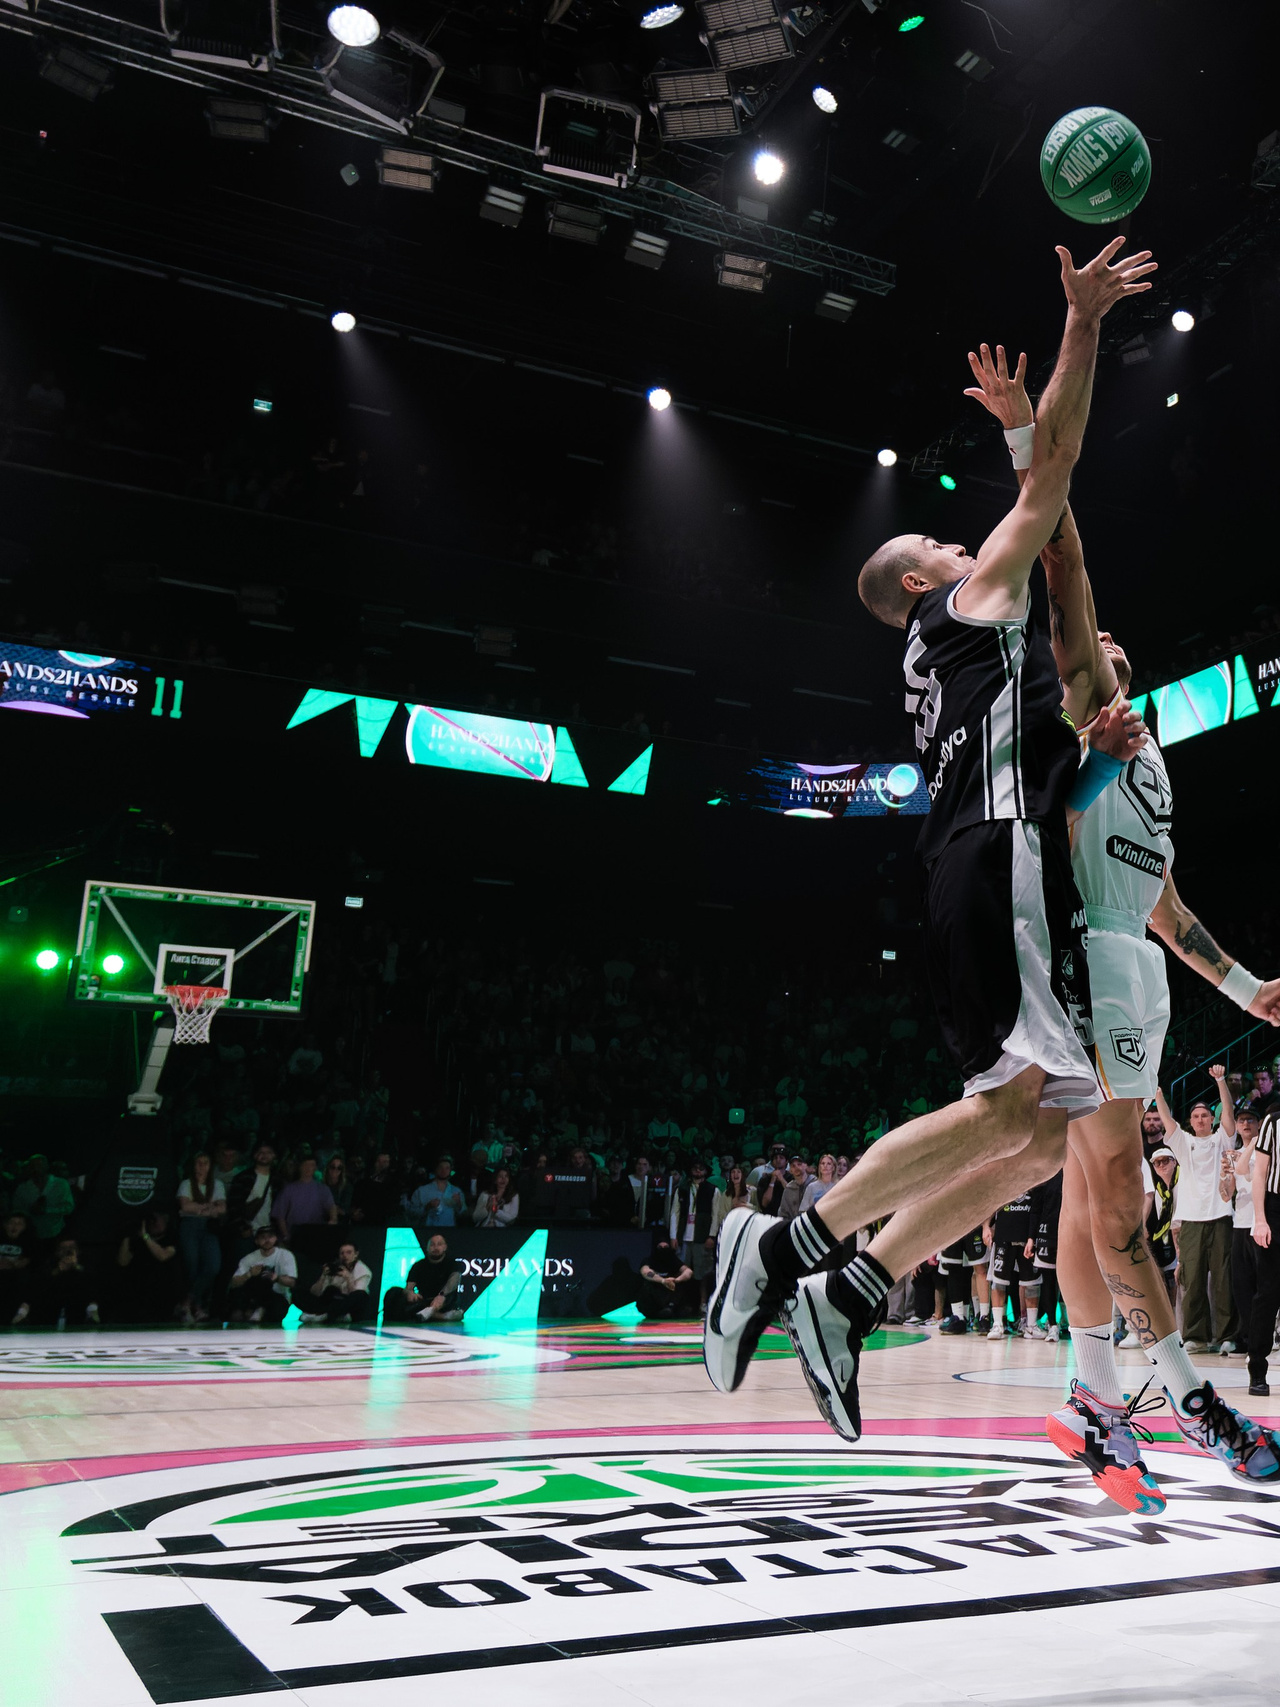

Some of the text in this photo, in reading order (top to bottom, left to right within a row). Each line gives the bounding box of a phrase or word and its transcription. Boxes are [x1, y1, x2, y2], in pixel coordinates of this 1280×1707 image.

[1093, 120, 1130, 151] LIGA
[1060, 133, 1109, 188] STAVOK
[0, 660, 139, 695] ANDS2HANDS
[2, 681, 136, 707] XURY RESALE
[151, 677, 184, 719] 11
[789, 794, 837, 803] LUXURY
[791, 777, 888, 793] HANDS2HAND
[1113, 839, 1163, 874] Winline
